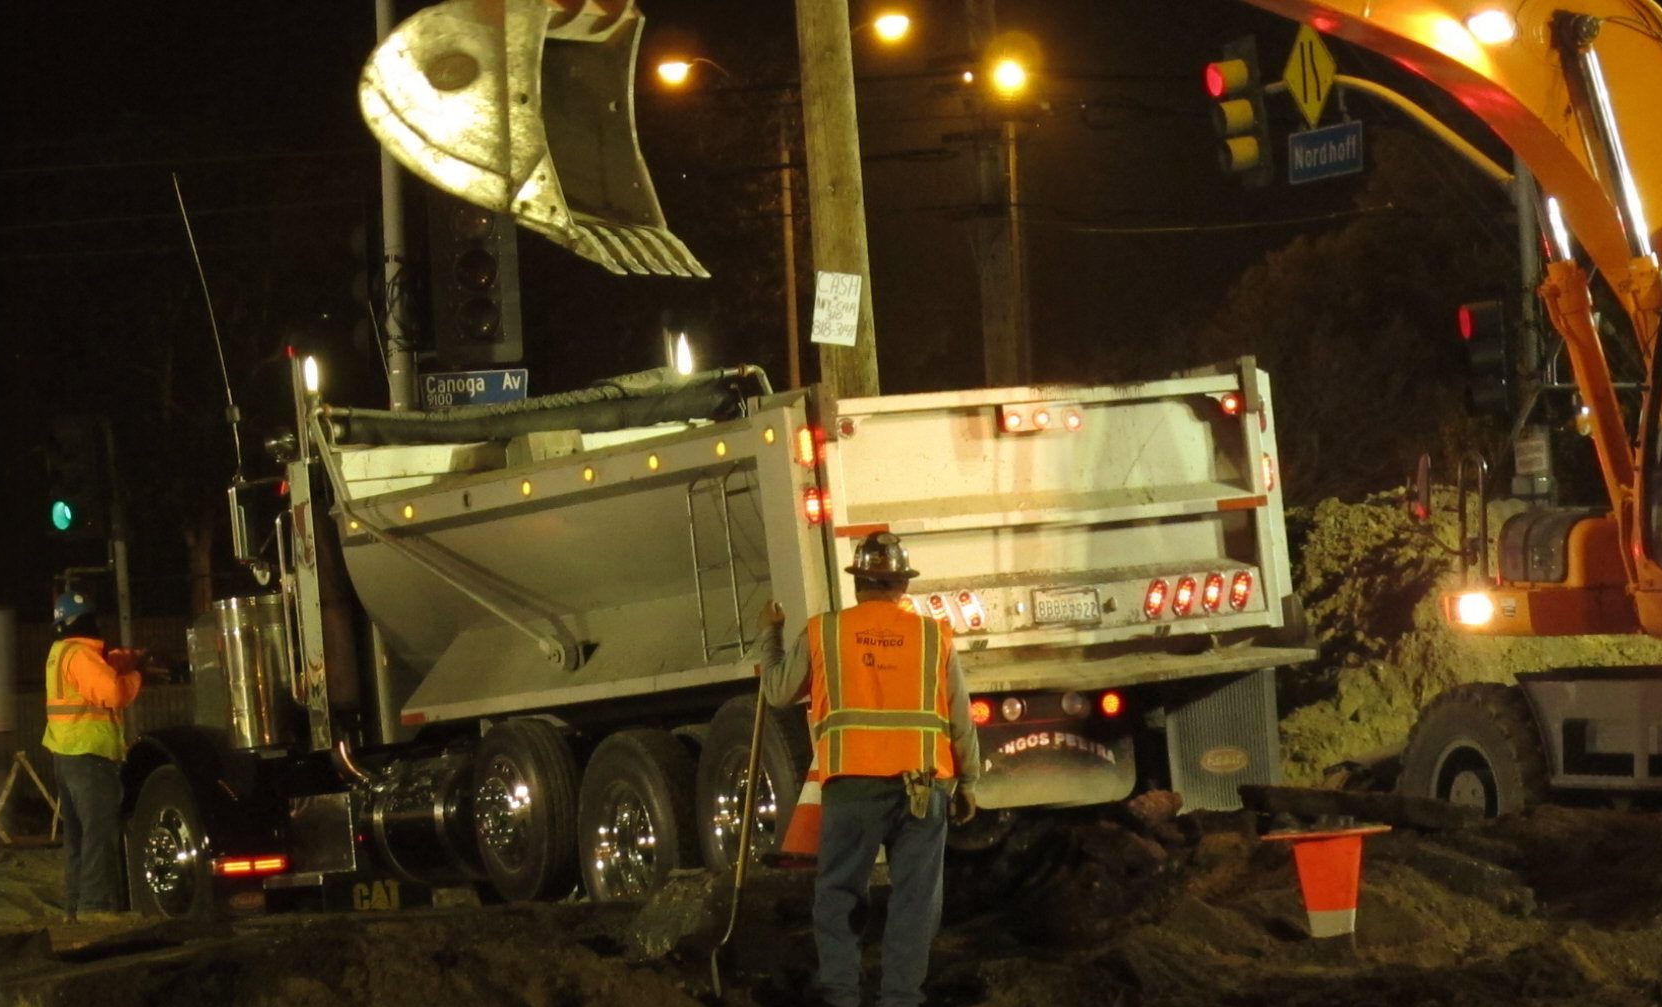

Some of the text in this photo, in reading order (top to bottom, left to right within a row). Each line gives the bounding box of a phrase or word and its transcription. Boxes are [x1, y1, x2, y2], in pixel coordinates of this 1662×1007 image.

[1294, 134, 1357, 170] Nordhoff
[426, 371, 521, 398] Canoga Av
[426, 393, 453, 406] 9100
[352, 880, 400, 911] CAT
